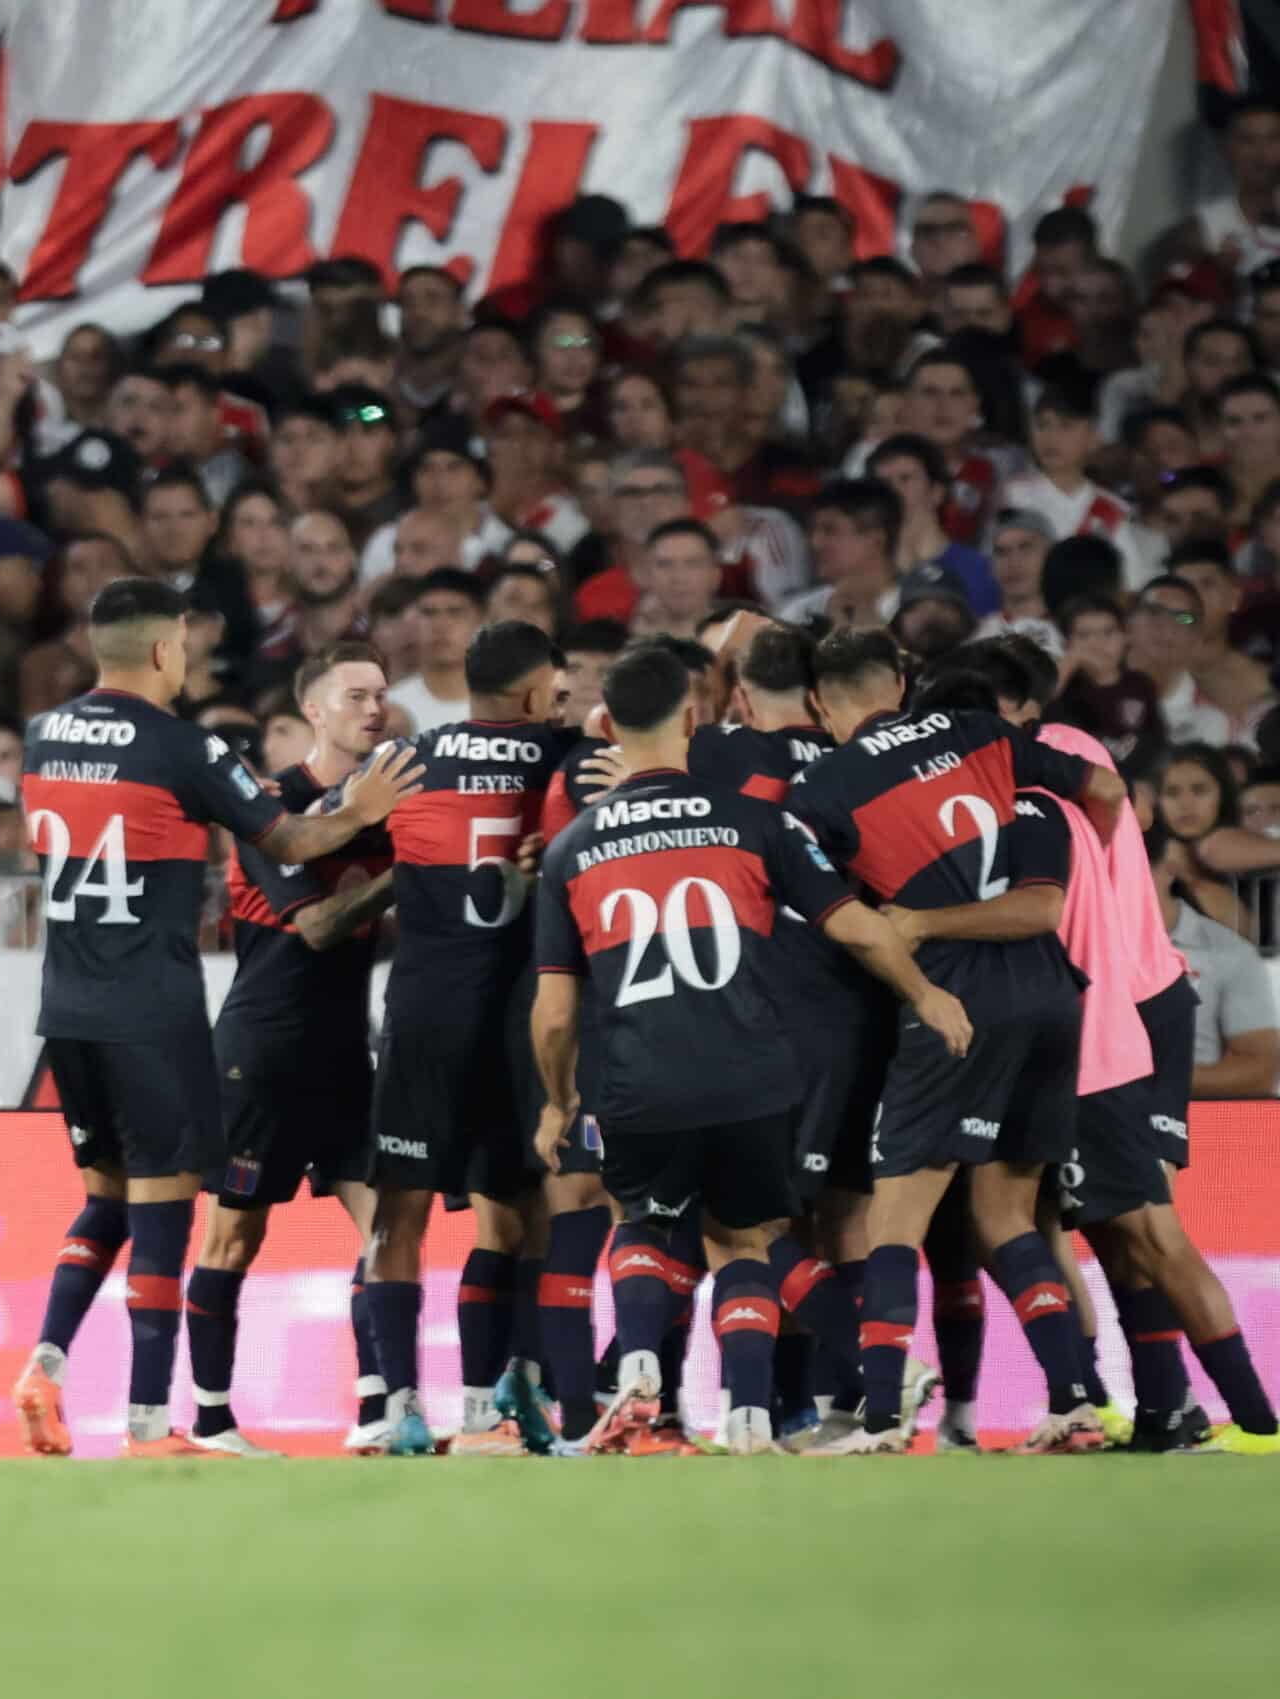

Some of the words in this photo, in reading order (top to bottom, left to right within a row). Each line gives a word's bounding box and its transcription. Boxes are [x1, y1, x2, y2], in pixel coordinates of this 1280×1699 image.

[40, 712, 136, 746] Macro
[433, 732, 543, 763] Macro
[857, 712, 951, 756] Macro
[39, 759, 119, 784] ALVAREZ
[457, 774, 525, 795] LEYES
[912, 751, 962, 783] LASO
[594, 796, 712, 831] Macro
[28, 807, 145, 924] 24
[575, 826, 740, 872] BARRIONUEVO
[937, 794, 1011, 901] 2
[463, 814, 528, 928] 5
[599, 876, 742, 1008] 20
